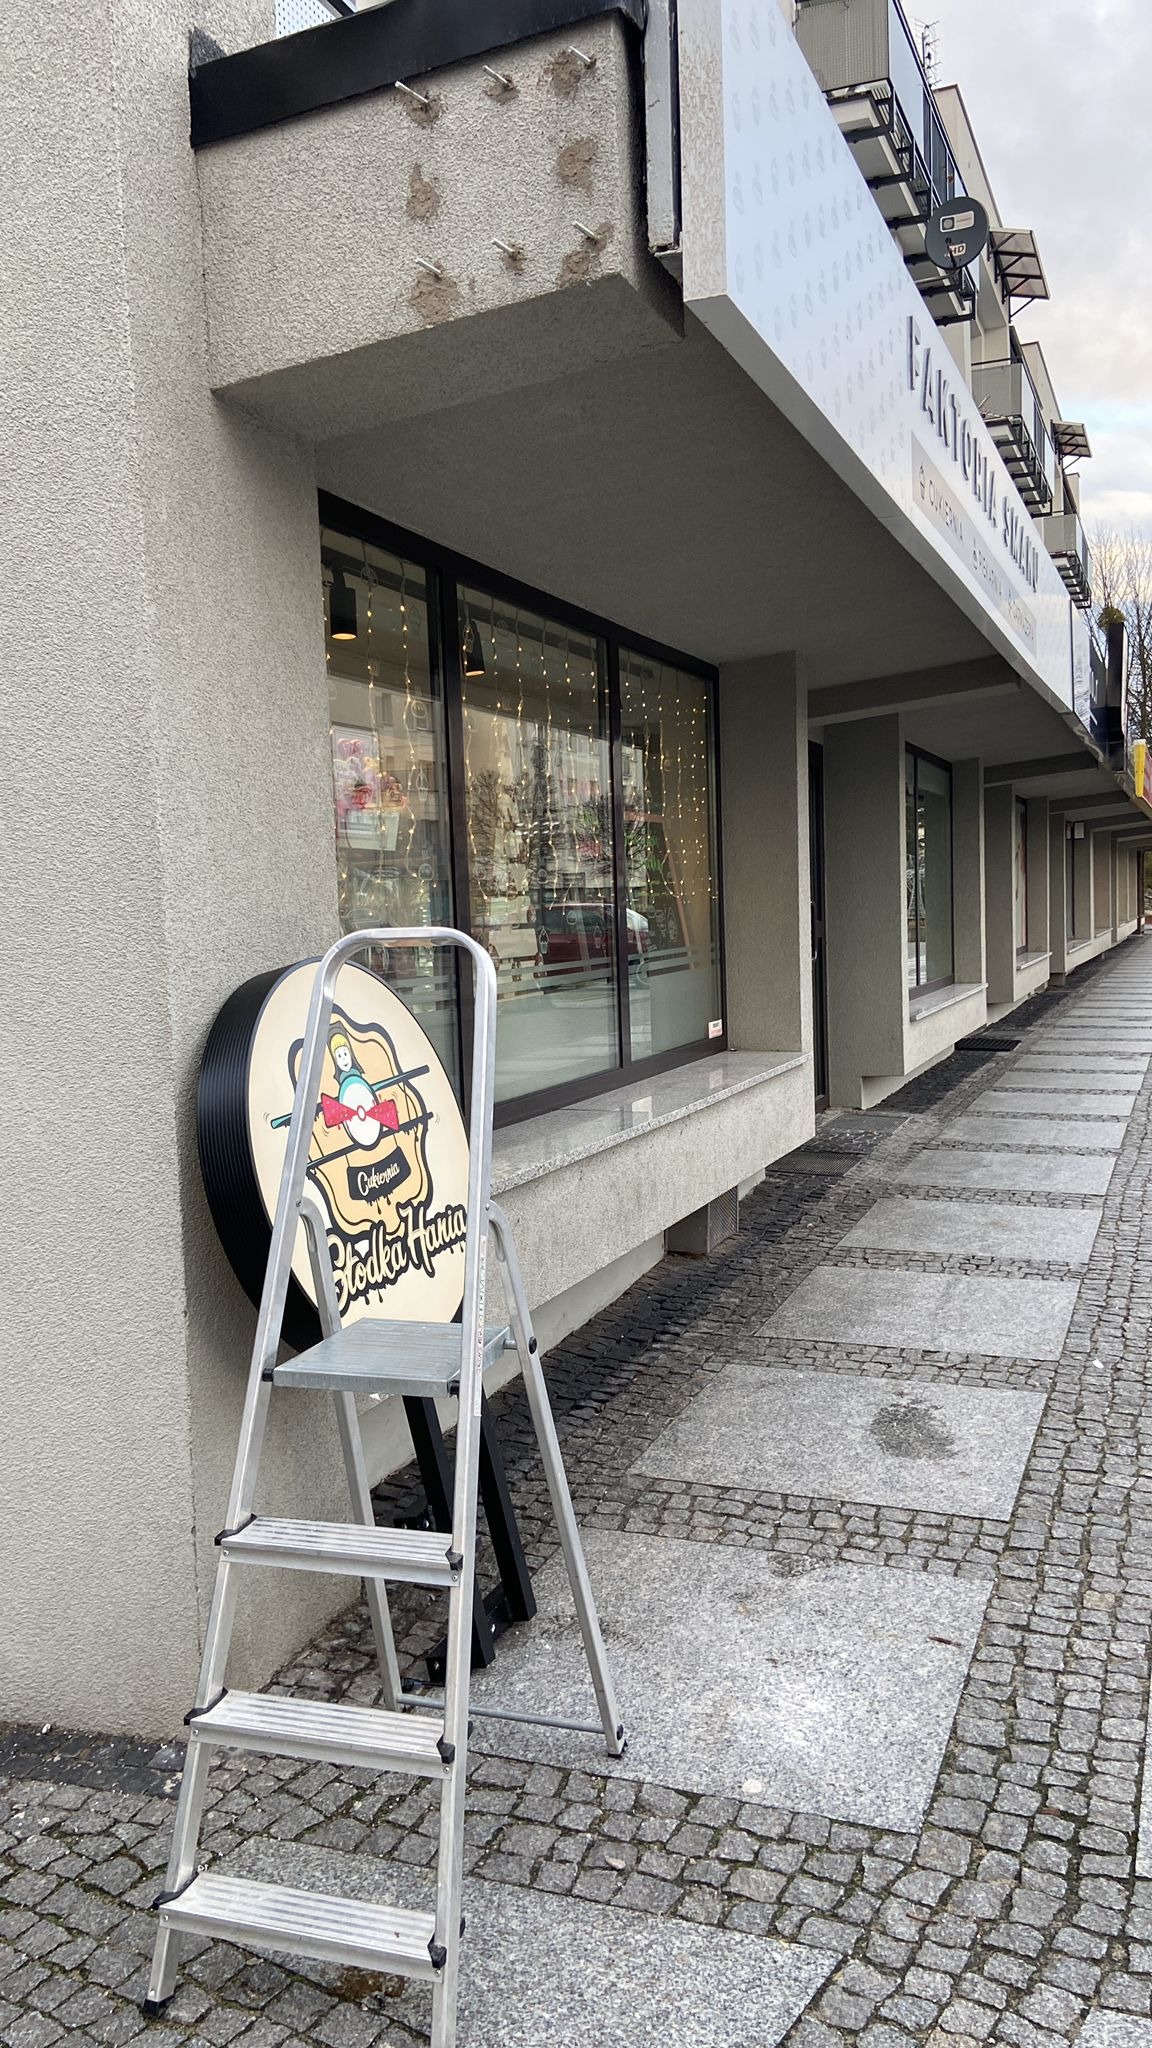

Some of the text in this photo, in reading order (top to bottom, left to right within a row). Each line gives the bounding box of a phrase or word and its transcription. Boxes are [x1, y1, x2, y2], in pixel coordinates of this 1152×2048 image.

[907, 315, 1039, 594] FAKTORIA SMAKU
[357, 1162, 401, 1197] Cukiernia
[399, 1205, 468, 1274] Hania
